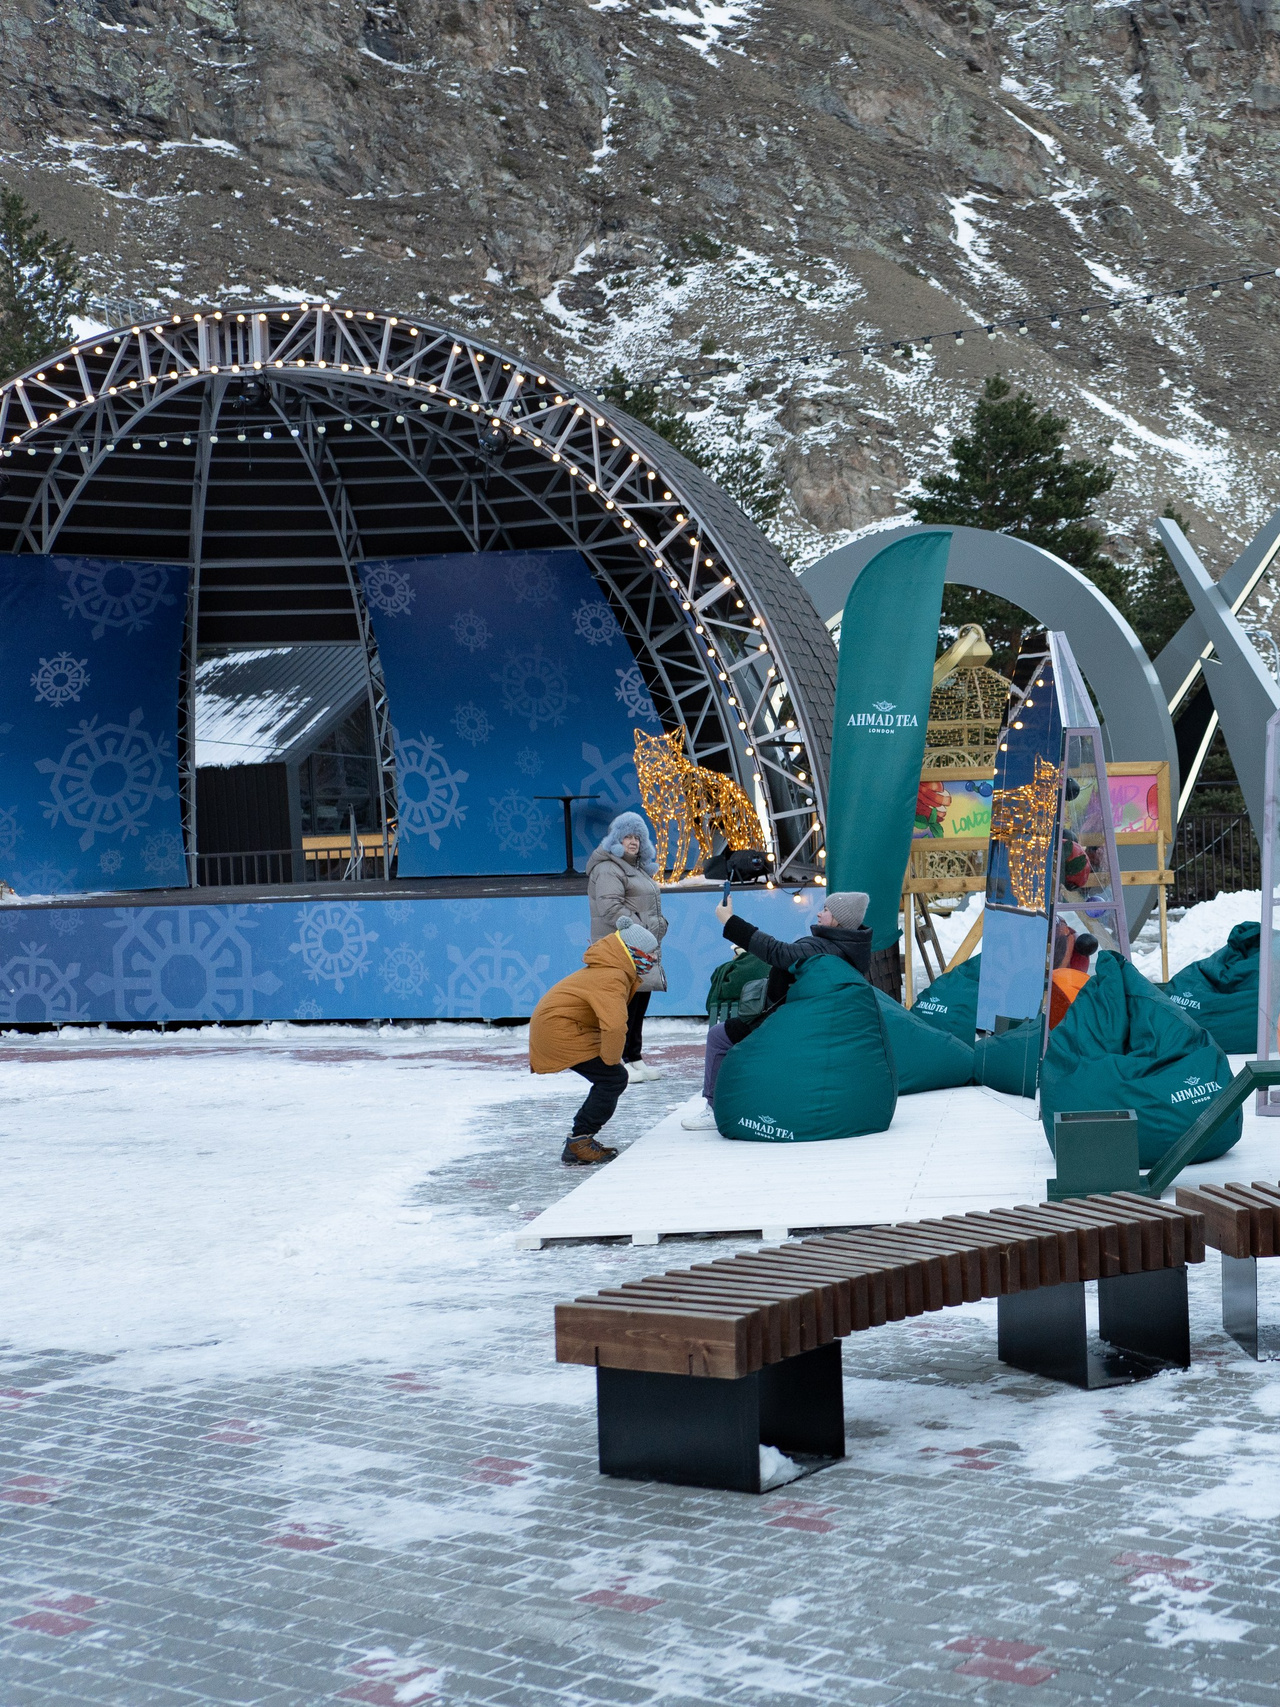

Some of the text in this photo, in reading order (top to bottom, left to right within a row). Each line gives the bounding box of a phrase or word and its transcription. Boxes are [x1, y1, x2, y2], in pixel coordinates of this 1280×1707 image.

[847, 713, 919, 727] AHMAD TEA
[935, 1004, 948, 1014] TEA
[1171, 1081, 1223, 1104] AHMAD TEA
[738, 1116, 795, 1140] AHMAD TEA
